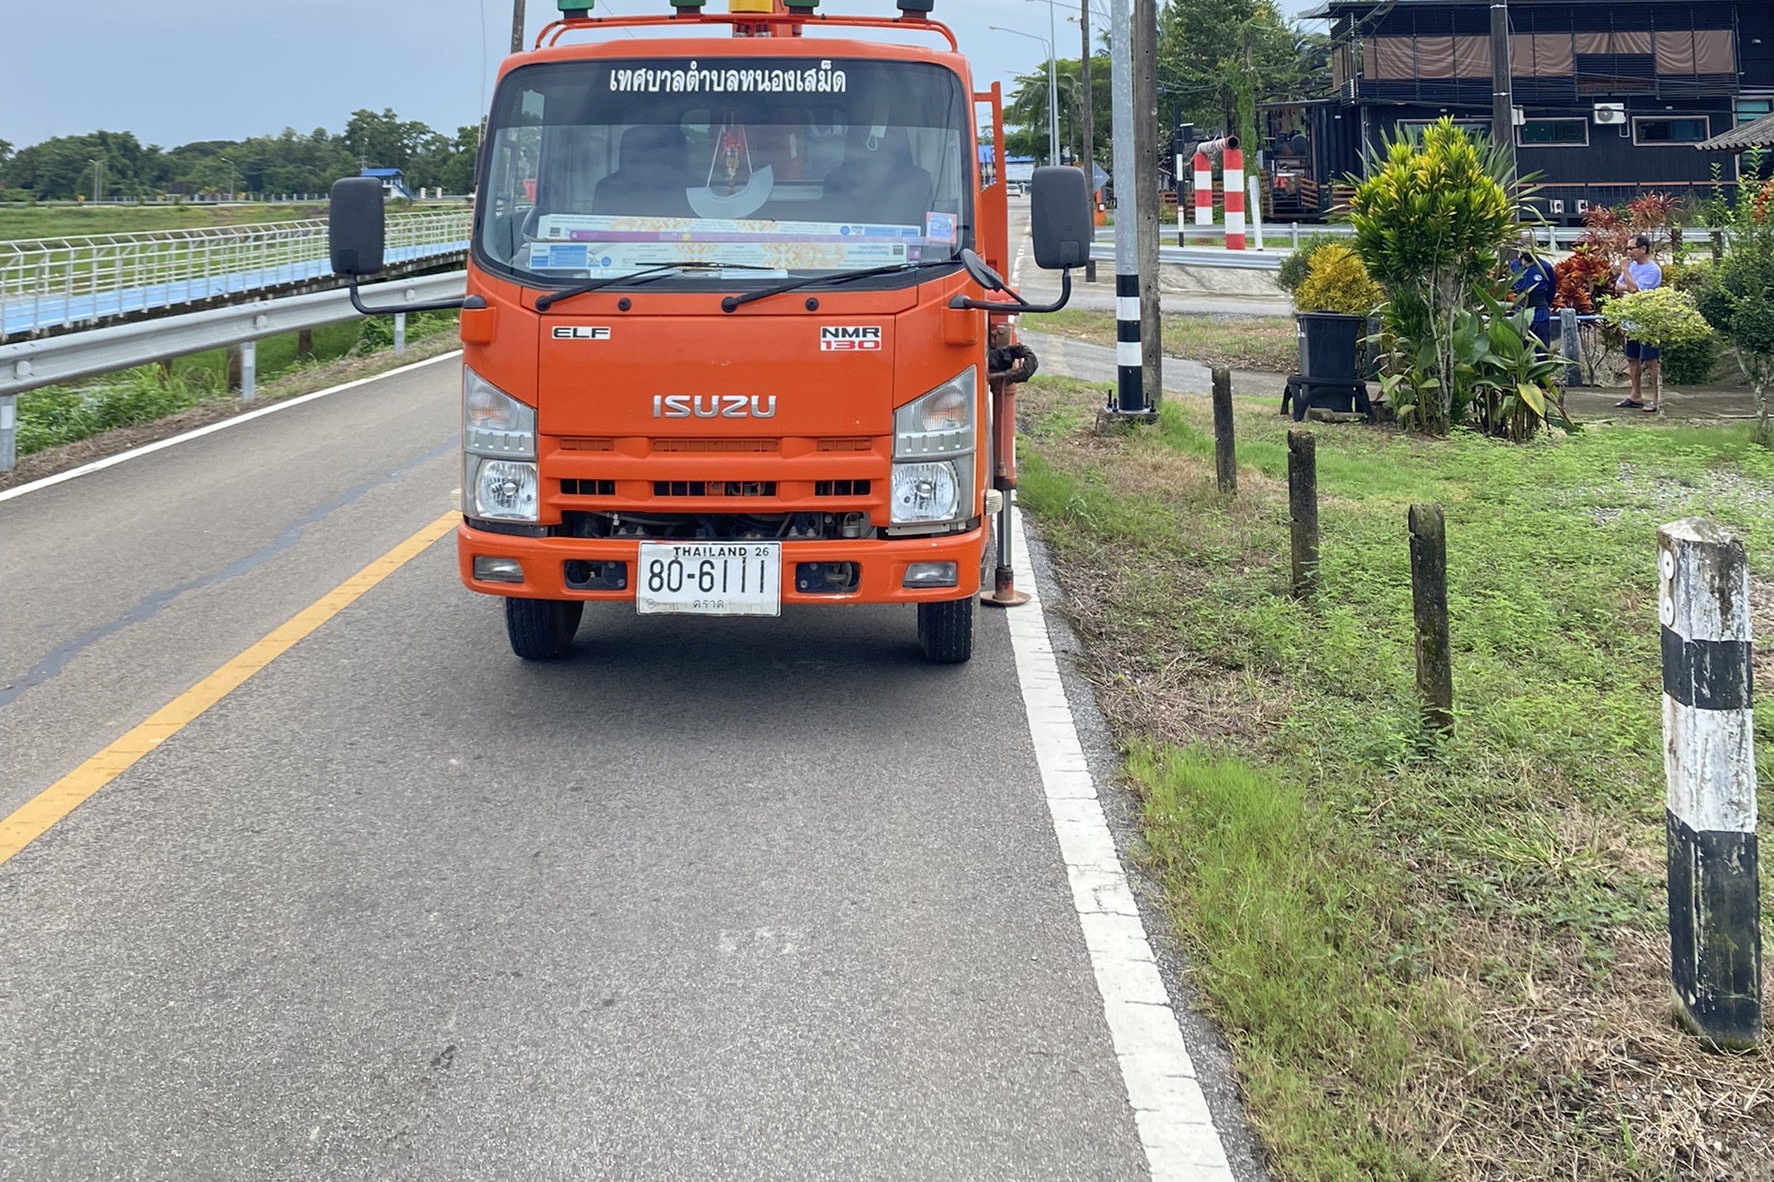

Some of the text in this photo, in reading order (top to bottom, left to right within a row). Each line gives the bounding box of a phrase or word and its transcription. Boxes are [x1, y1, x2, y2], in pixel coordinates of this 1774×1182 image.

[609, 60, 847, 93] เทศบาลตำบลหนองเสม็ด
[553, 327, 609, 338] ELF
[822, 327, 880, 338] NMR
[822, 340, 880, 350] 130
[653, 395, 777, 418] ISUZU
[673, 546, 769, 557] THAILAND 26
[648, 559, 765, 594] 80-6111
